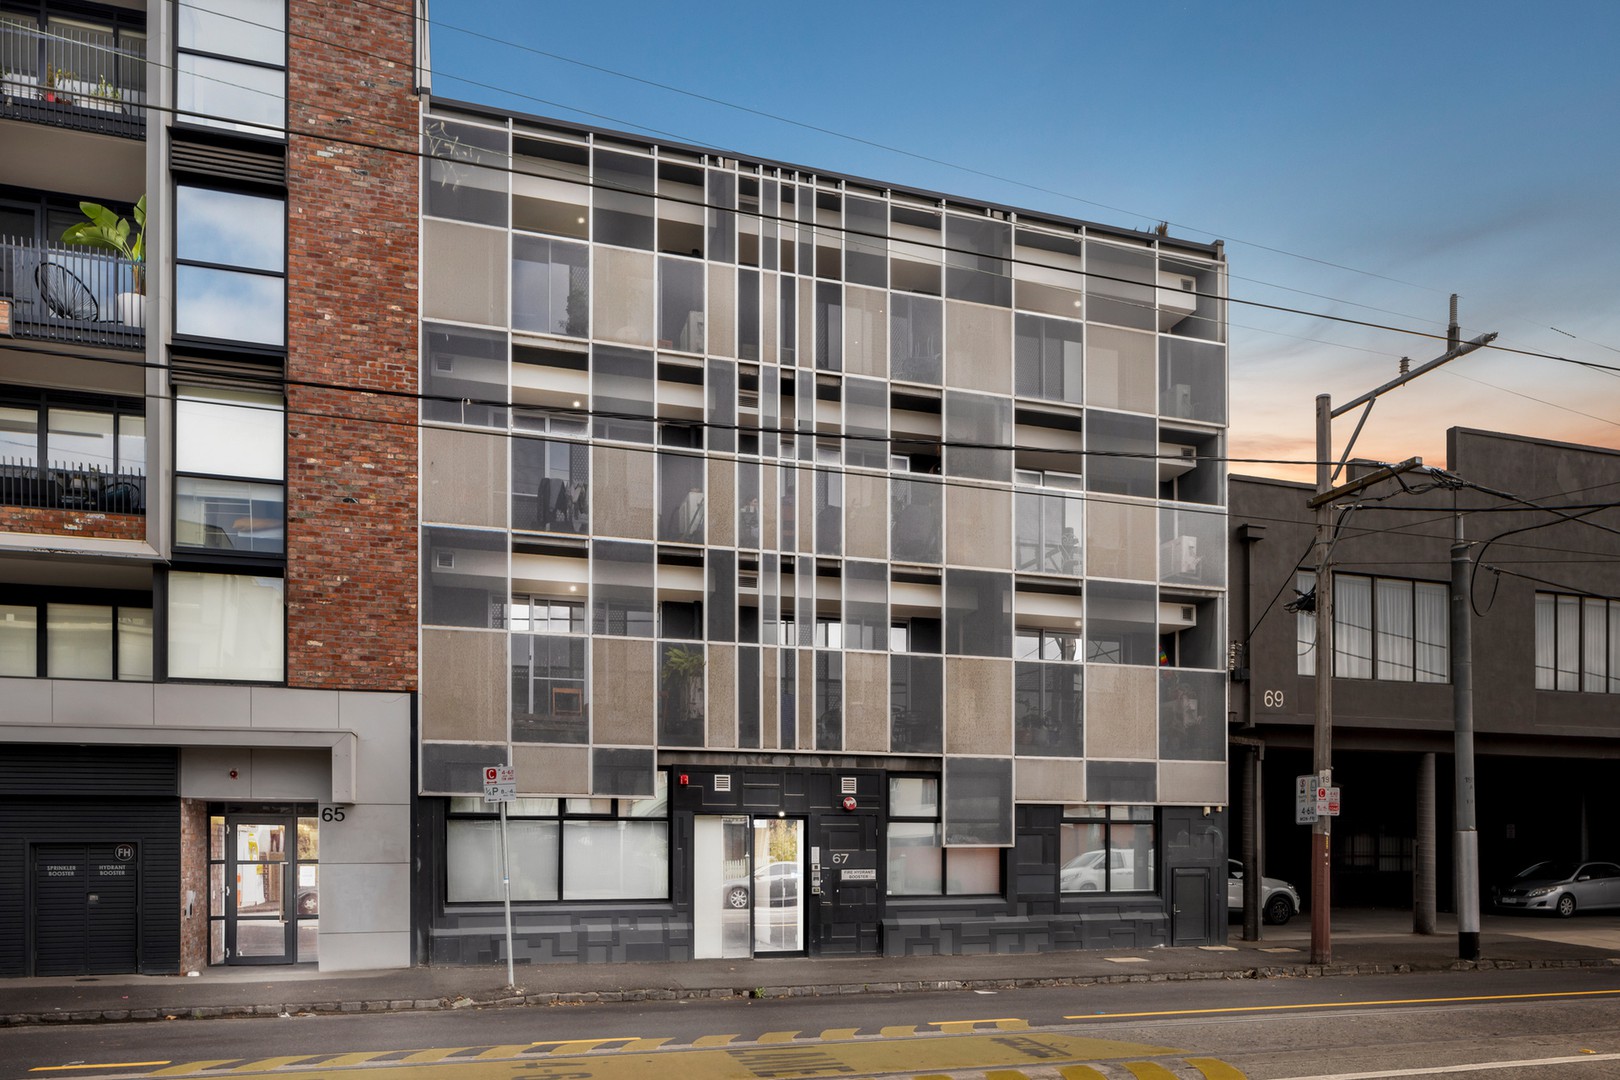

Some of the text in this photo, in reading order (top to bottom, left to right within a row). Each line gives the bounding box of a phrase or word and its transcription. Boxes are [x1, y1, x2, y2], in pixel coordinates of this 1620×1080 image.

[1264, 690, 1284, 708] 69
[488, 770, 495, 778] C
[321, 807, 345, 822] 65
[118, 848, 131, 857] FH
[832, 853, 849, 864] 67
